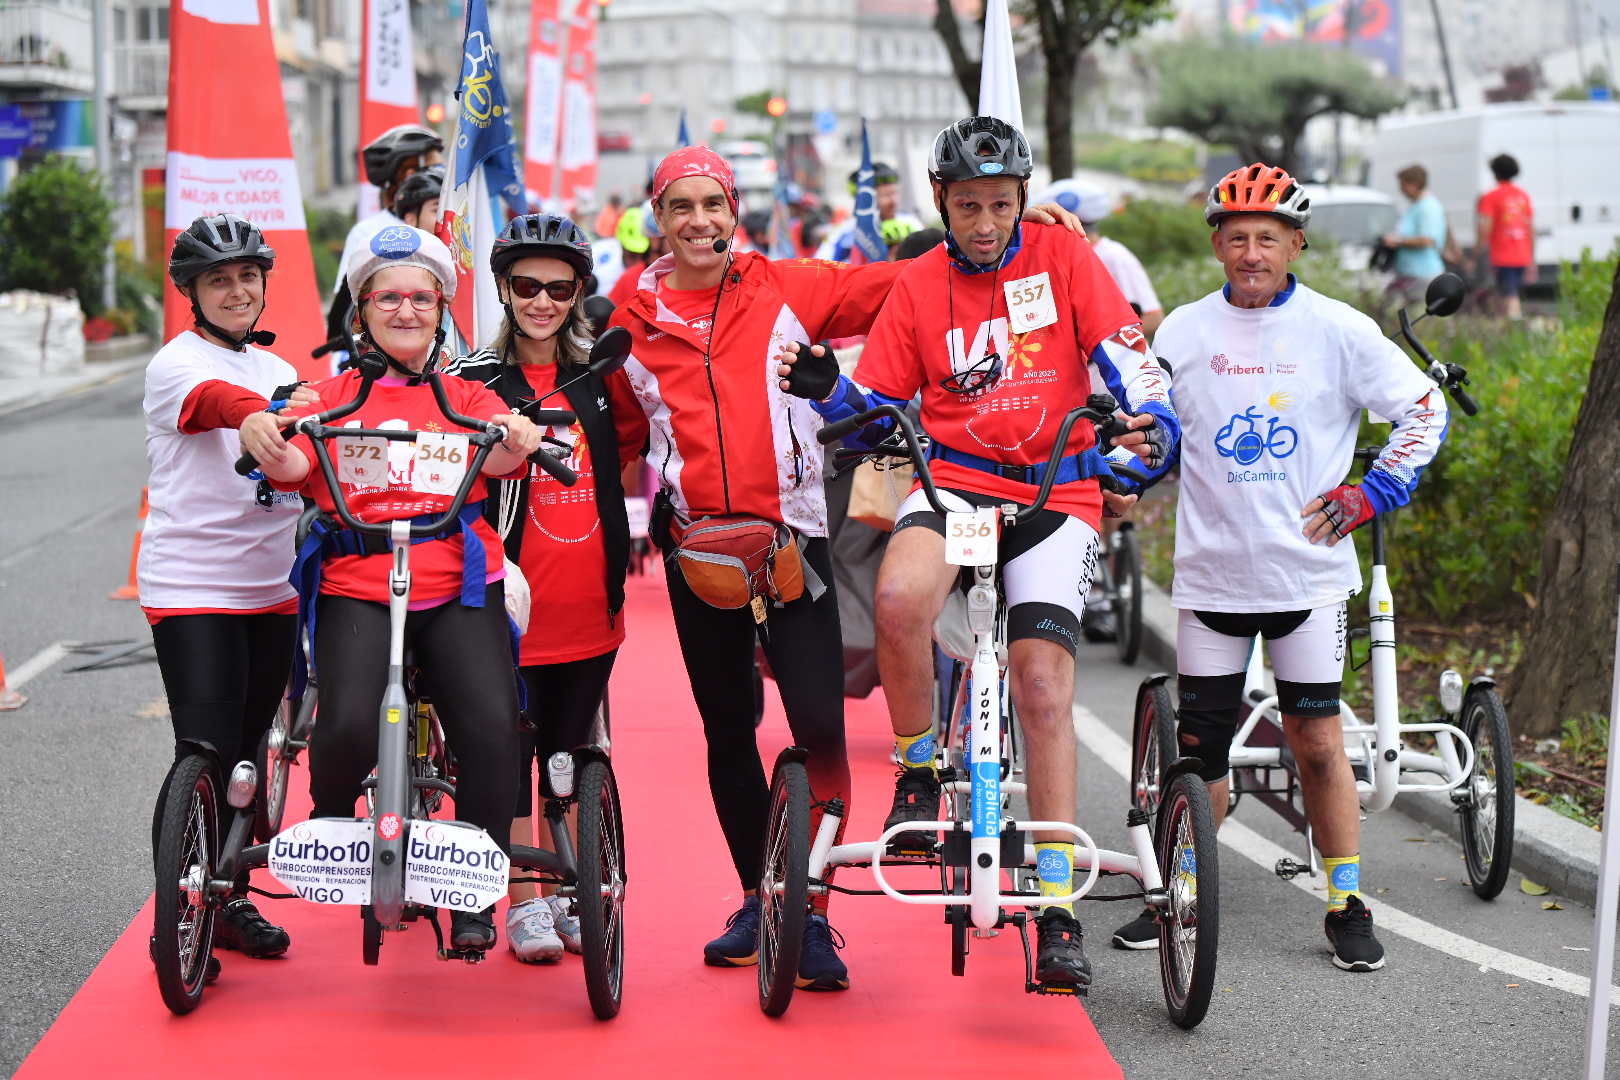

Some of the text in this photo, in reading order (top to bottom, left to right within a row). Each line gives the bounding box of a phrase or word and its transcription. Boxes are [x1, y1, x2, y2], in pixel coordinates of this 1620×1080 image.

[223, 189, 283, 204] CIDADE
[242, 208, 286, 223] VIVIR
[1012, 283, 1045, 306] 557
[1023, 370, 1057, 379] AÑO 2023
[1226, 365, 1265, 376] ribera
[343, 445, 381, 460] 572
[418, 444, 462, 464] 546
[1227, 470, 1286, 483] DisCamino
[951, 521, 991, 538] 556
[1077, 541, 1092, 597] Ciclos
[1334, 610, 1344, 662] Ciclos
[979, 746, 992, 756] M
[986, 778, 998, 837] galicia
[274, 837, 371, 863] turbo10
[411, 837, 505, 872] turbo10
[271, 861, 371, 877] TURBOCOMPRENSORES
[275, 872, 321, 884] DISTRIBUCIÓN
[407, 862, 505, 886] TURBOCOMPRENSORES
[409, 874, 455, 887] DISTRIBUCIÓN
[460, 880, 500, 893] REPARACIÓN
[296, 885, 344, 904] VIGO
